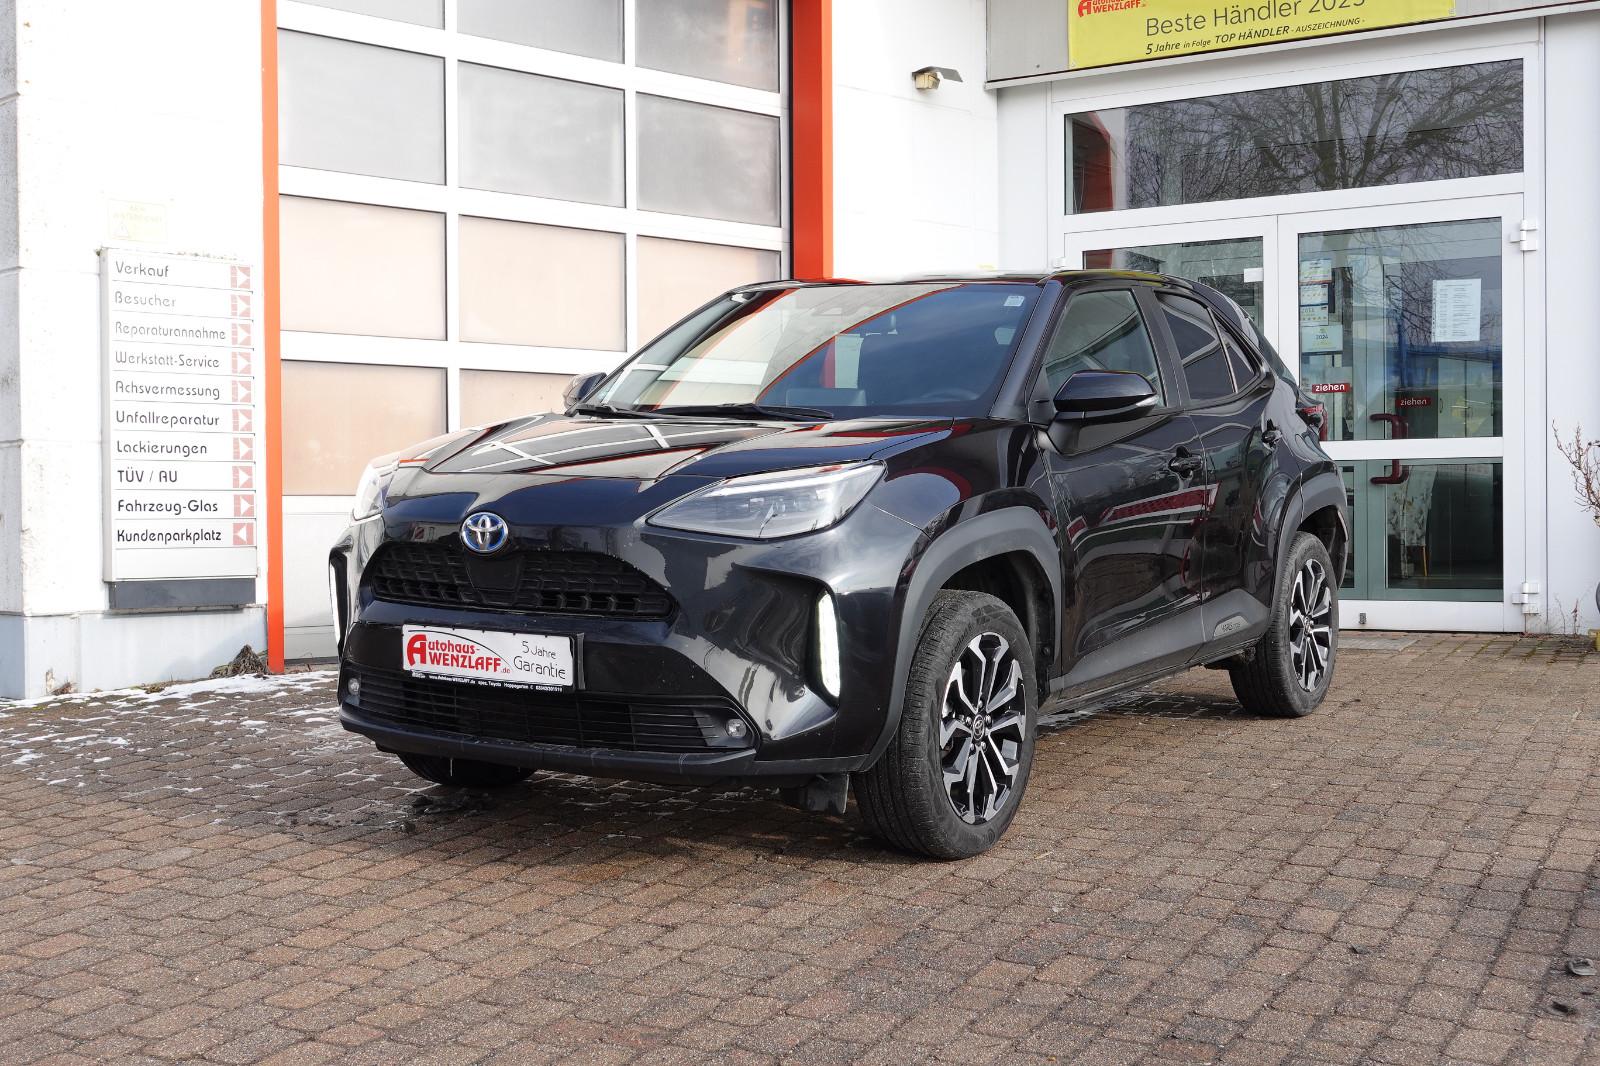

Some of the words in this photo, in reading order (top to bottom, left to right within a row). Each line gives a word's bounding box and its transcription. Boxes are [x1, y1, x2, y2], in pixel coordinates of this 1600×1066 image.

[1146, 13, 1206, 37] Beste
[1213, 1, 1301, 27] Händler
[1145, 43, 1153, 55] 5
[1154, 41, 1181, 53] Jahre
[1191, 38, 1211, 48] Folge
[1215, 34, 1236, 44] TOP
[1238, 25, 1290, 41] HÄNDLER
[1295, 17, 1360, 33] AUSZEICHNUNG
[115, 260, 169, 278] Verkauf
[114, 290, 176, 307] Besucher
[115, 321, 226, 340] Reparaturannahme
[115, 351, 220, 368] Werkstatt-Service
[116, 380, 220, 400] Achsvermessung
[1315, 383, 1345, 392] ziehen
[1400, 398, 1427, 406] ziehen
[116, 410, 220, 428] Unfallreparatur
[117, 440, 207, 457] Lackierungen
[117, 466, 144, 483] TÜV
[159, 470, 178, 483] AU
[118, 499, 218, 516] Fahrzeug-Glas
[117, 528, 222, 545] Kundenparkplatz
[522, 640, 530, 654] 5
[530, 646, 557, 660] Jahre
[513, 656, 566, 680] Garantie
